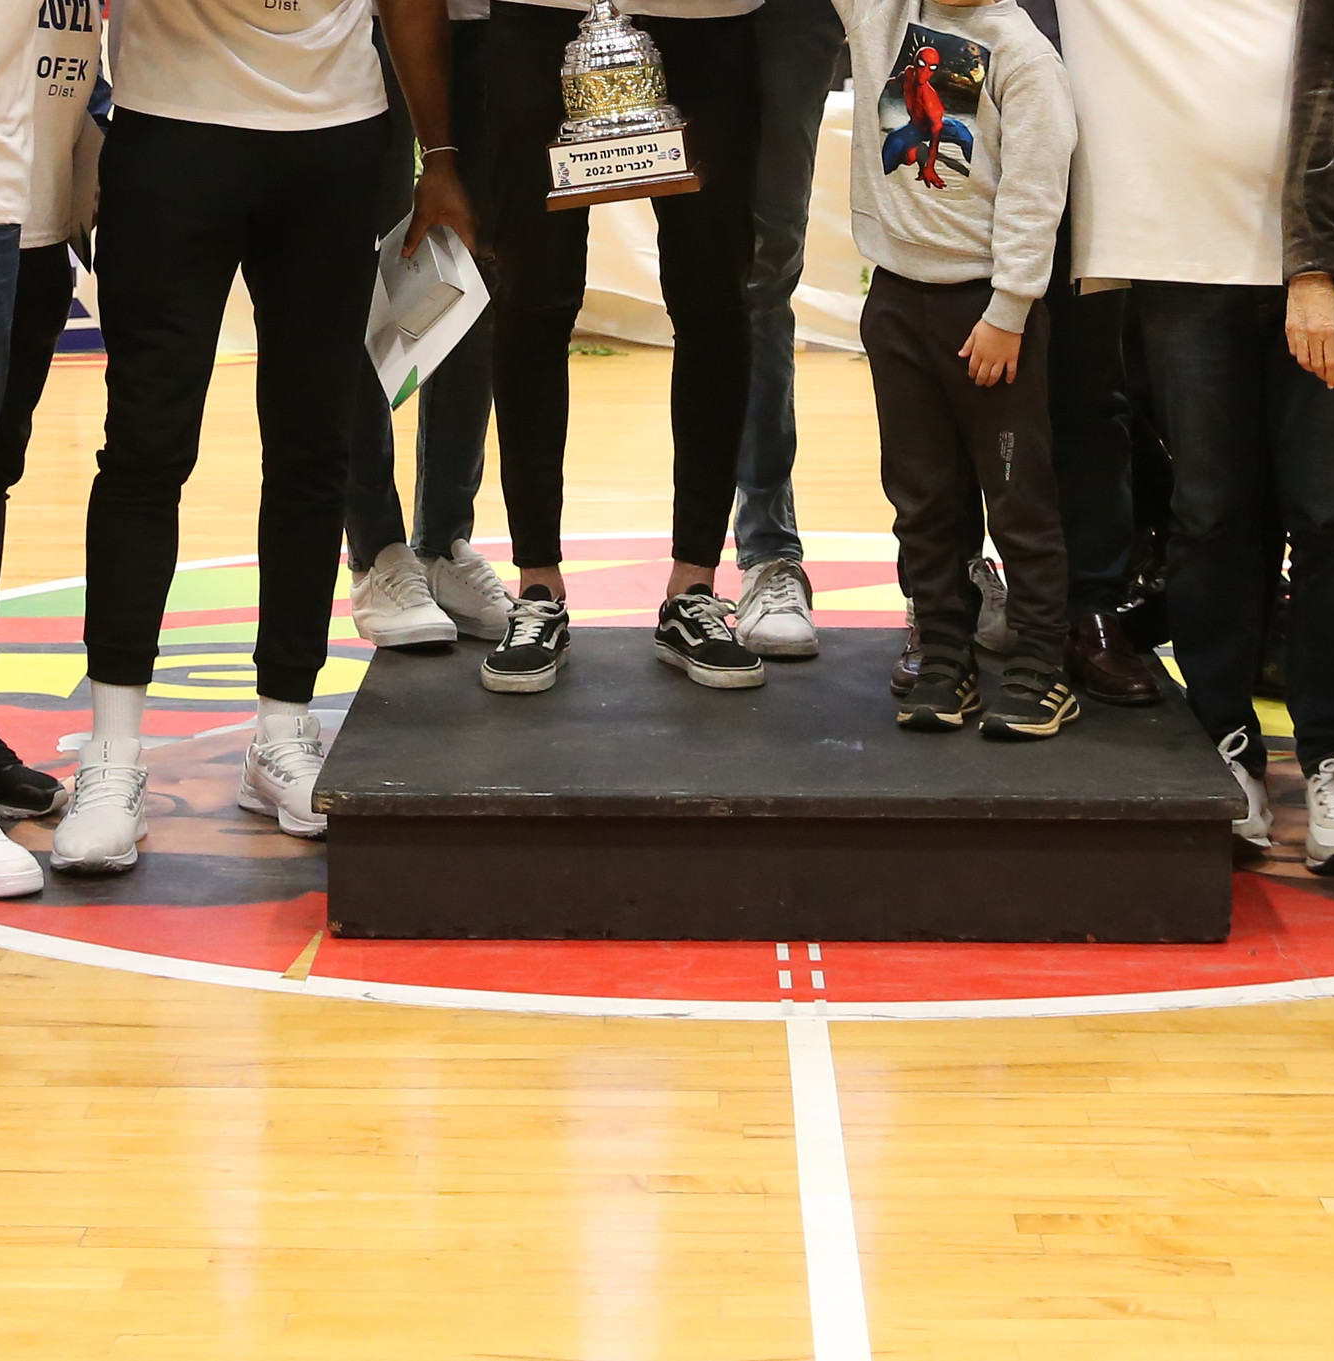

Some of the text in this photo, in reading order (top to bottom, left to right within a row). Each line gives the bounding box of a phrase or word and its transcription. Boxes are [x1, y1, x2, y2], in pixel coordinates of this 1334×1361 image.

[36, 56, 88, 81] OFEK
[48, 84, 76, 98] Dist.
[570, 143, 658, 163] גביע המדינה מגדל
[585, 165, 613, 177] 2022
[616, 160, 653, 172] לגברים
